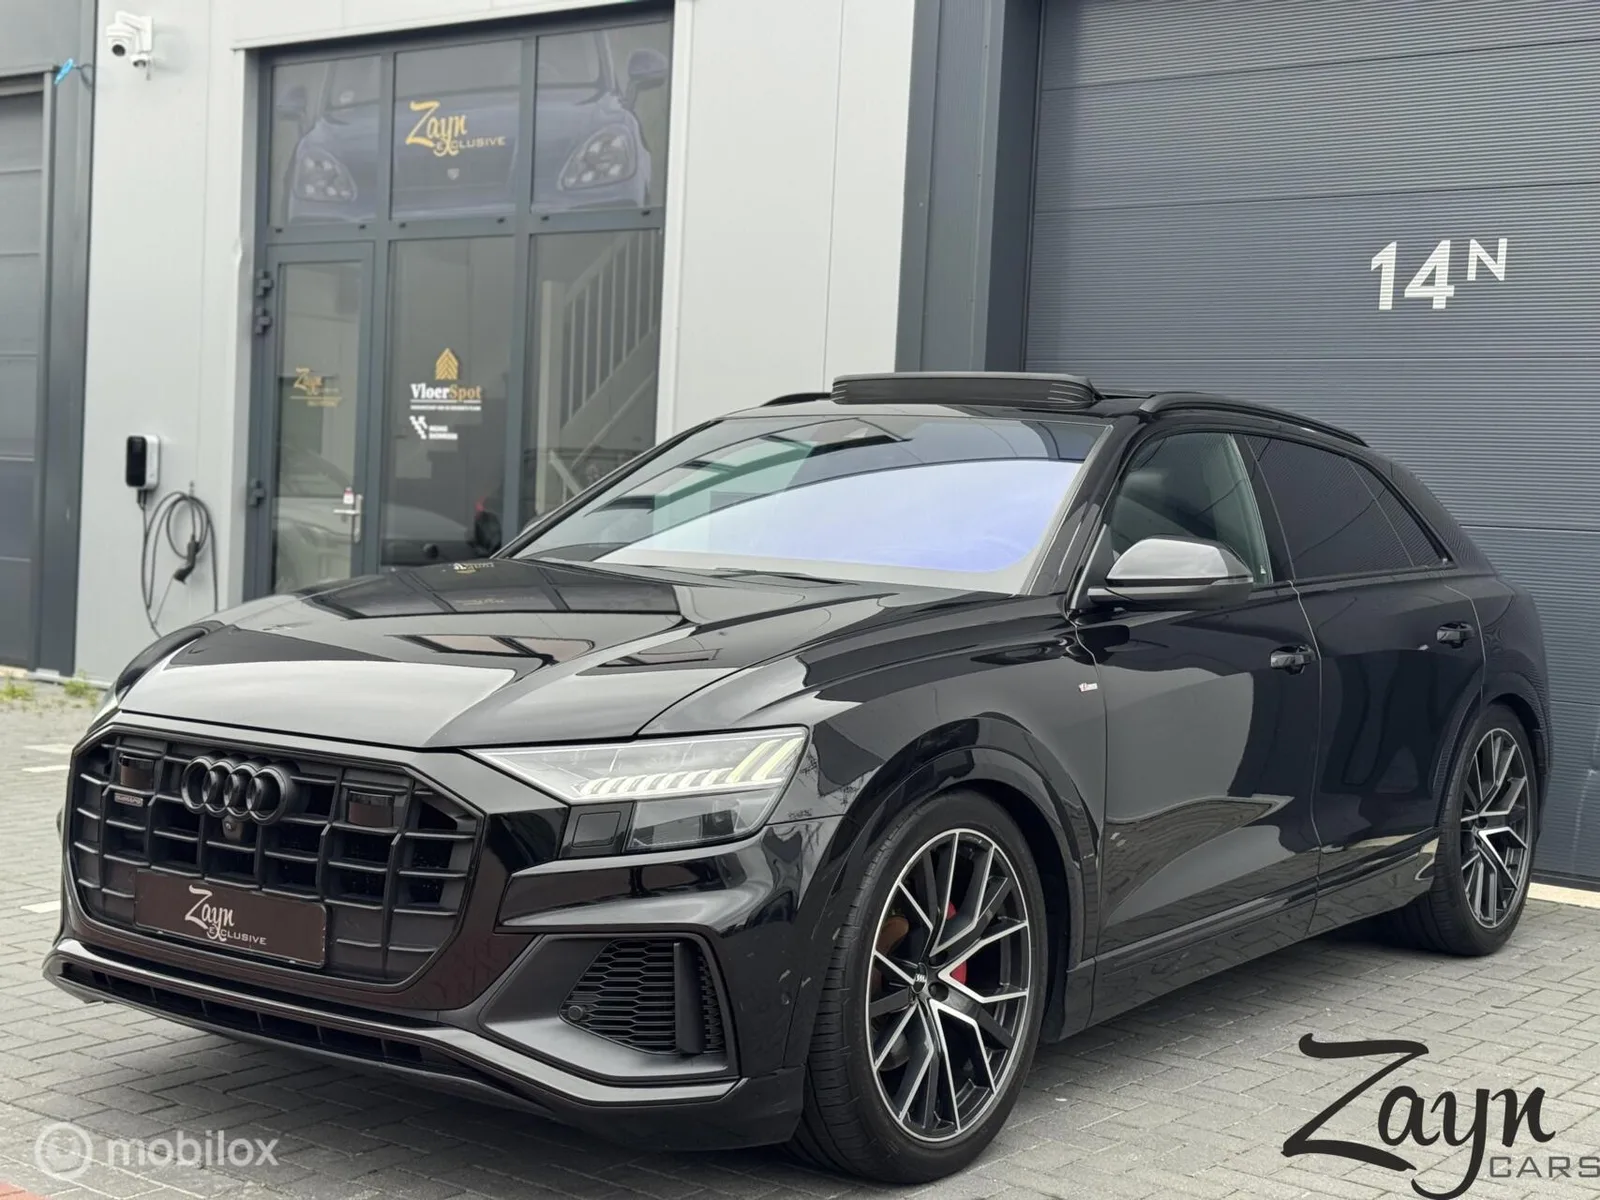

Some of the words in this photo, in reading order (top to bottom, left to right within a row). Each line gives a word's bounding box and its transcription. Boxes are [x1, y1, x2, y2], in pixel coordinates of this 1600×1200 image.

[405, 101, 468, 156] Zayn
[409, 383, 482, 403] VloerSpot
[185, 884, 235, 941] Zayn
[207, 926, 267, 945] EXCLUSIVE
